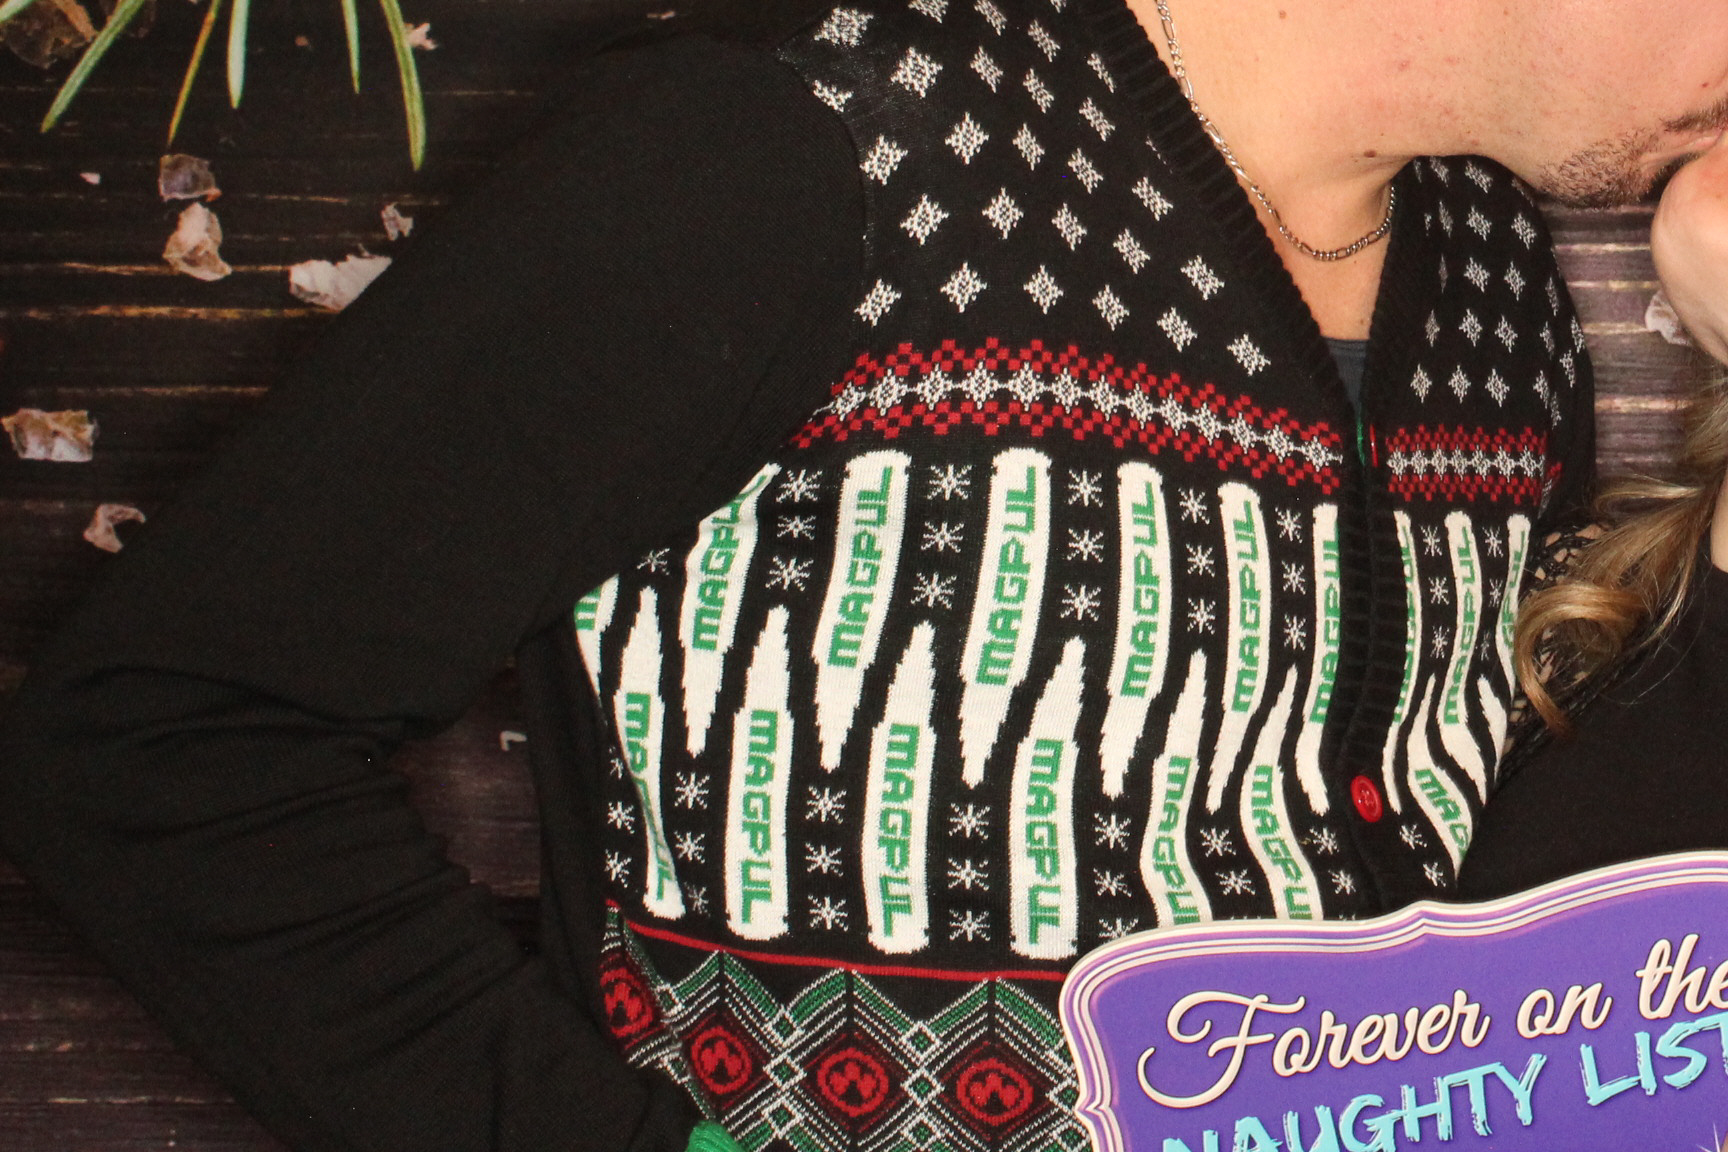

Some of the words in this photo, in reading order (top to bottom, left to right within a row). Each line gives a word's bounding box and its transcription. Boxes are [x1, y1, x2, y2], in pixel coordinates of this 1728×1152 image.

[827, 466, 893, 668] MAGPUL
[975, 466, 1036, 686] MAGPUL
[1120, 481, 1156, 698] MAGPUL
[1232, 500, 1263, 713] MAGPUL
[1443, 526, 1475, 724] MAGPUL
[741, 710, 778, 923] MAGPUL
[878, 723, 920, 936] MAGPUL
[1025, 738, 1064, 945] MAGPUL
[1137, 988, 1490, 1108] Forever
[1516, 982, 1613, 1038] on
